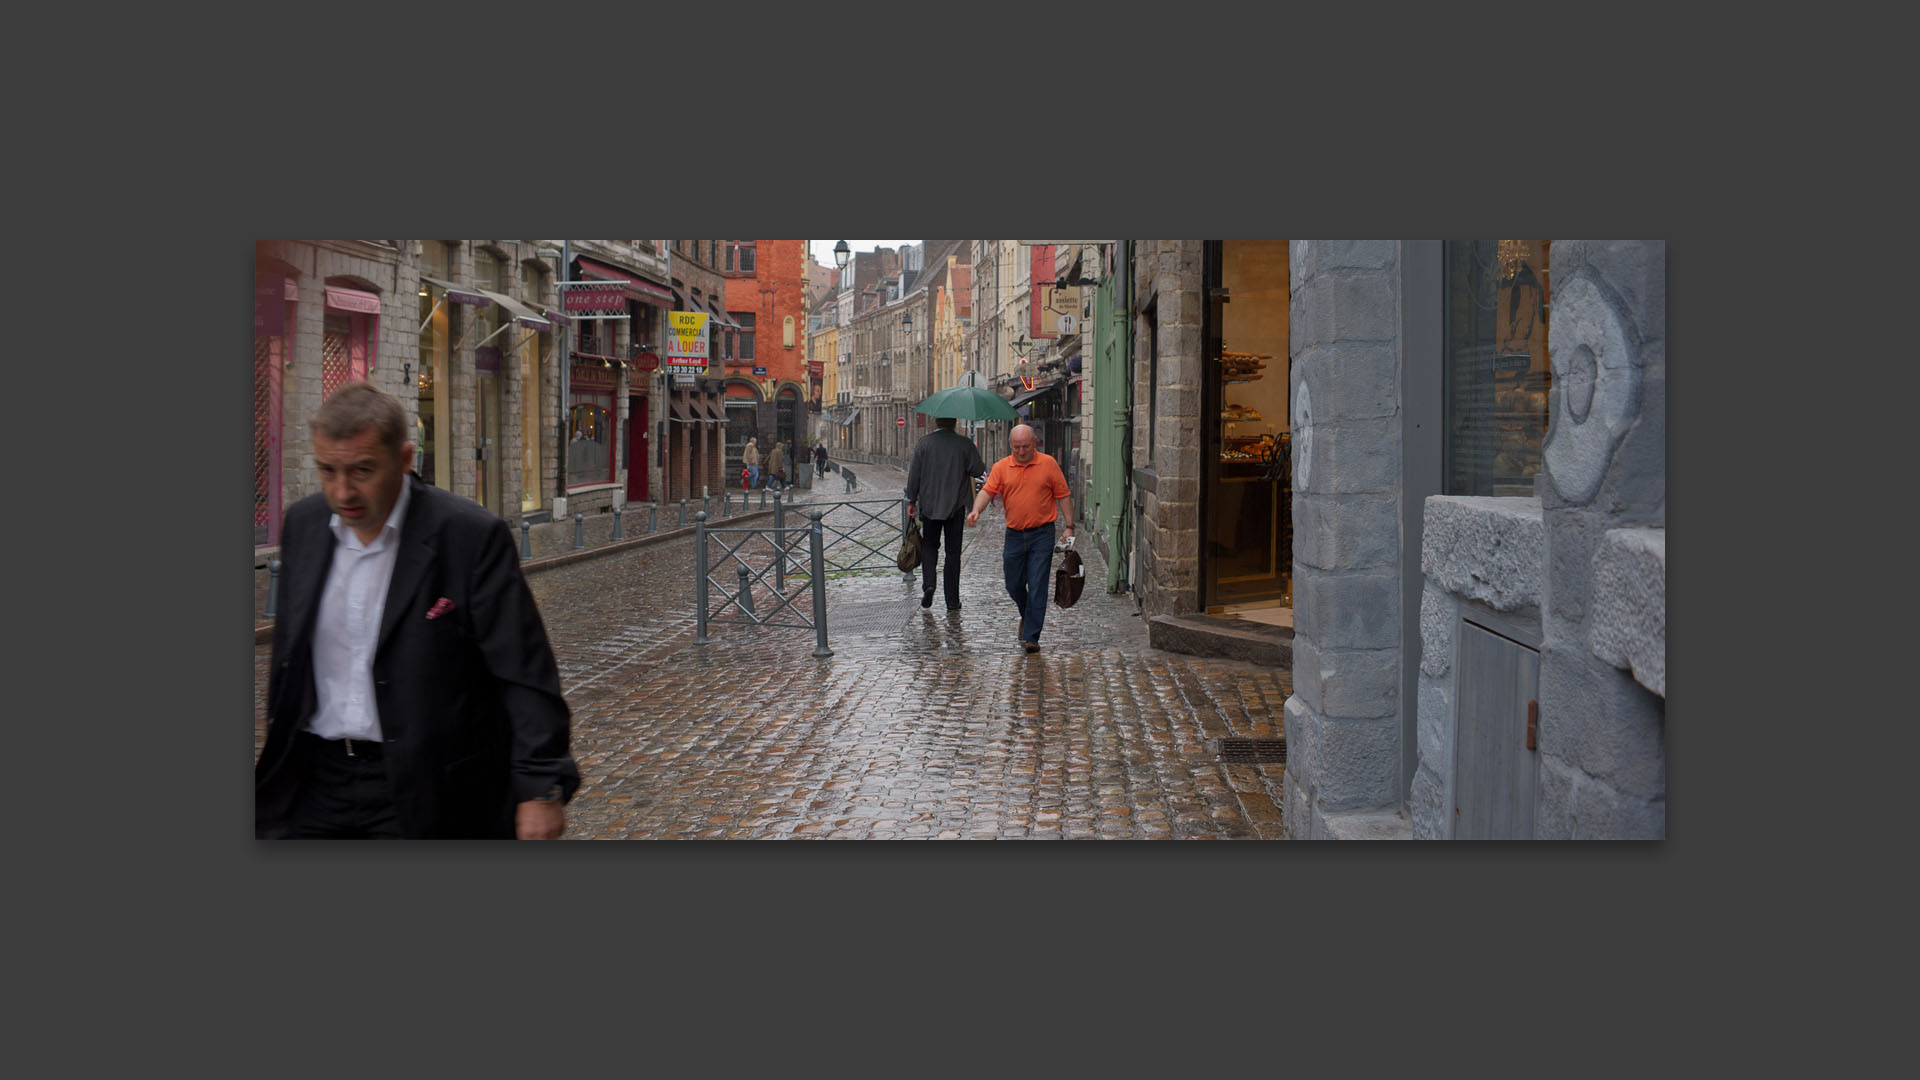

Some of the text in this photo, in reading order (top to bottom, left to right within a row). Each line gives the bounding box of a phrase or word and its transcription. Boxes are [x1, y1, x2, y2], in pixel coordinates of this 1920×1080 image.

[566, 294, 622, 307] one step
[679, 315, 696, 325] RDC
[668, 327, 705, 337] COMMERCIAL
[677, 341, 706, 353] LOUER
[688, 366, 695, 374] 22
